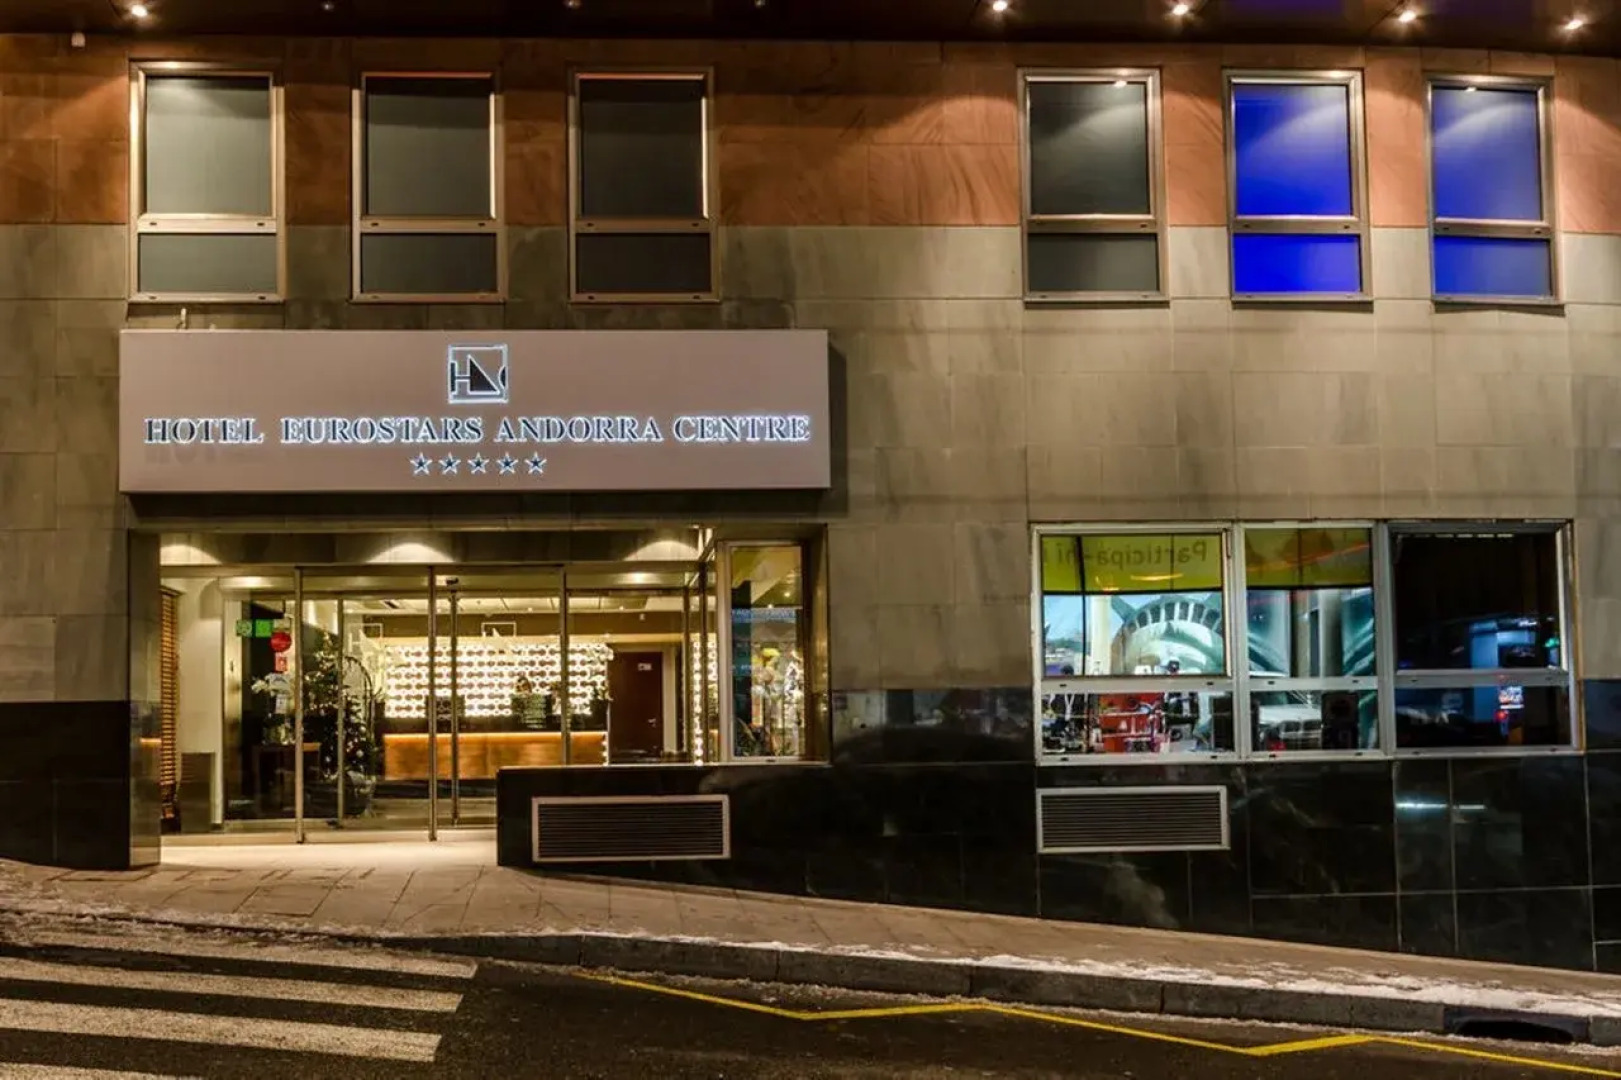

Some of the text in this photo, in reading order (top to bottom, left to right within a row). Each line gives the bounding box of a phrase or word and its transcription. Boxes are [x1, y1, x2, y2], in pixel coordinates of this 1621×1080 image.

[143, 414, 812, 445] HOTEL EUROSTARS ANDORRA CENTRE
